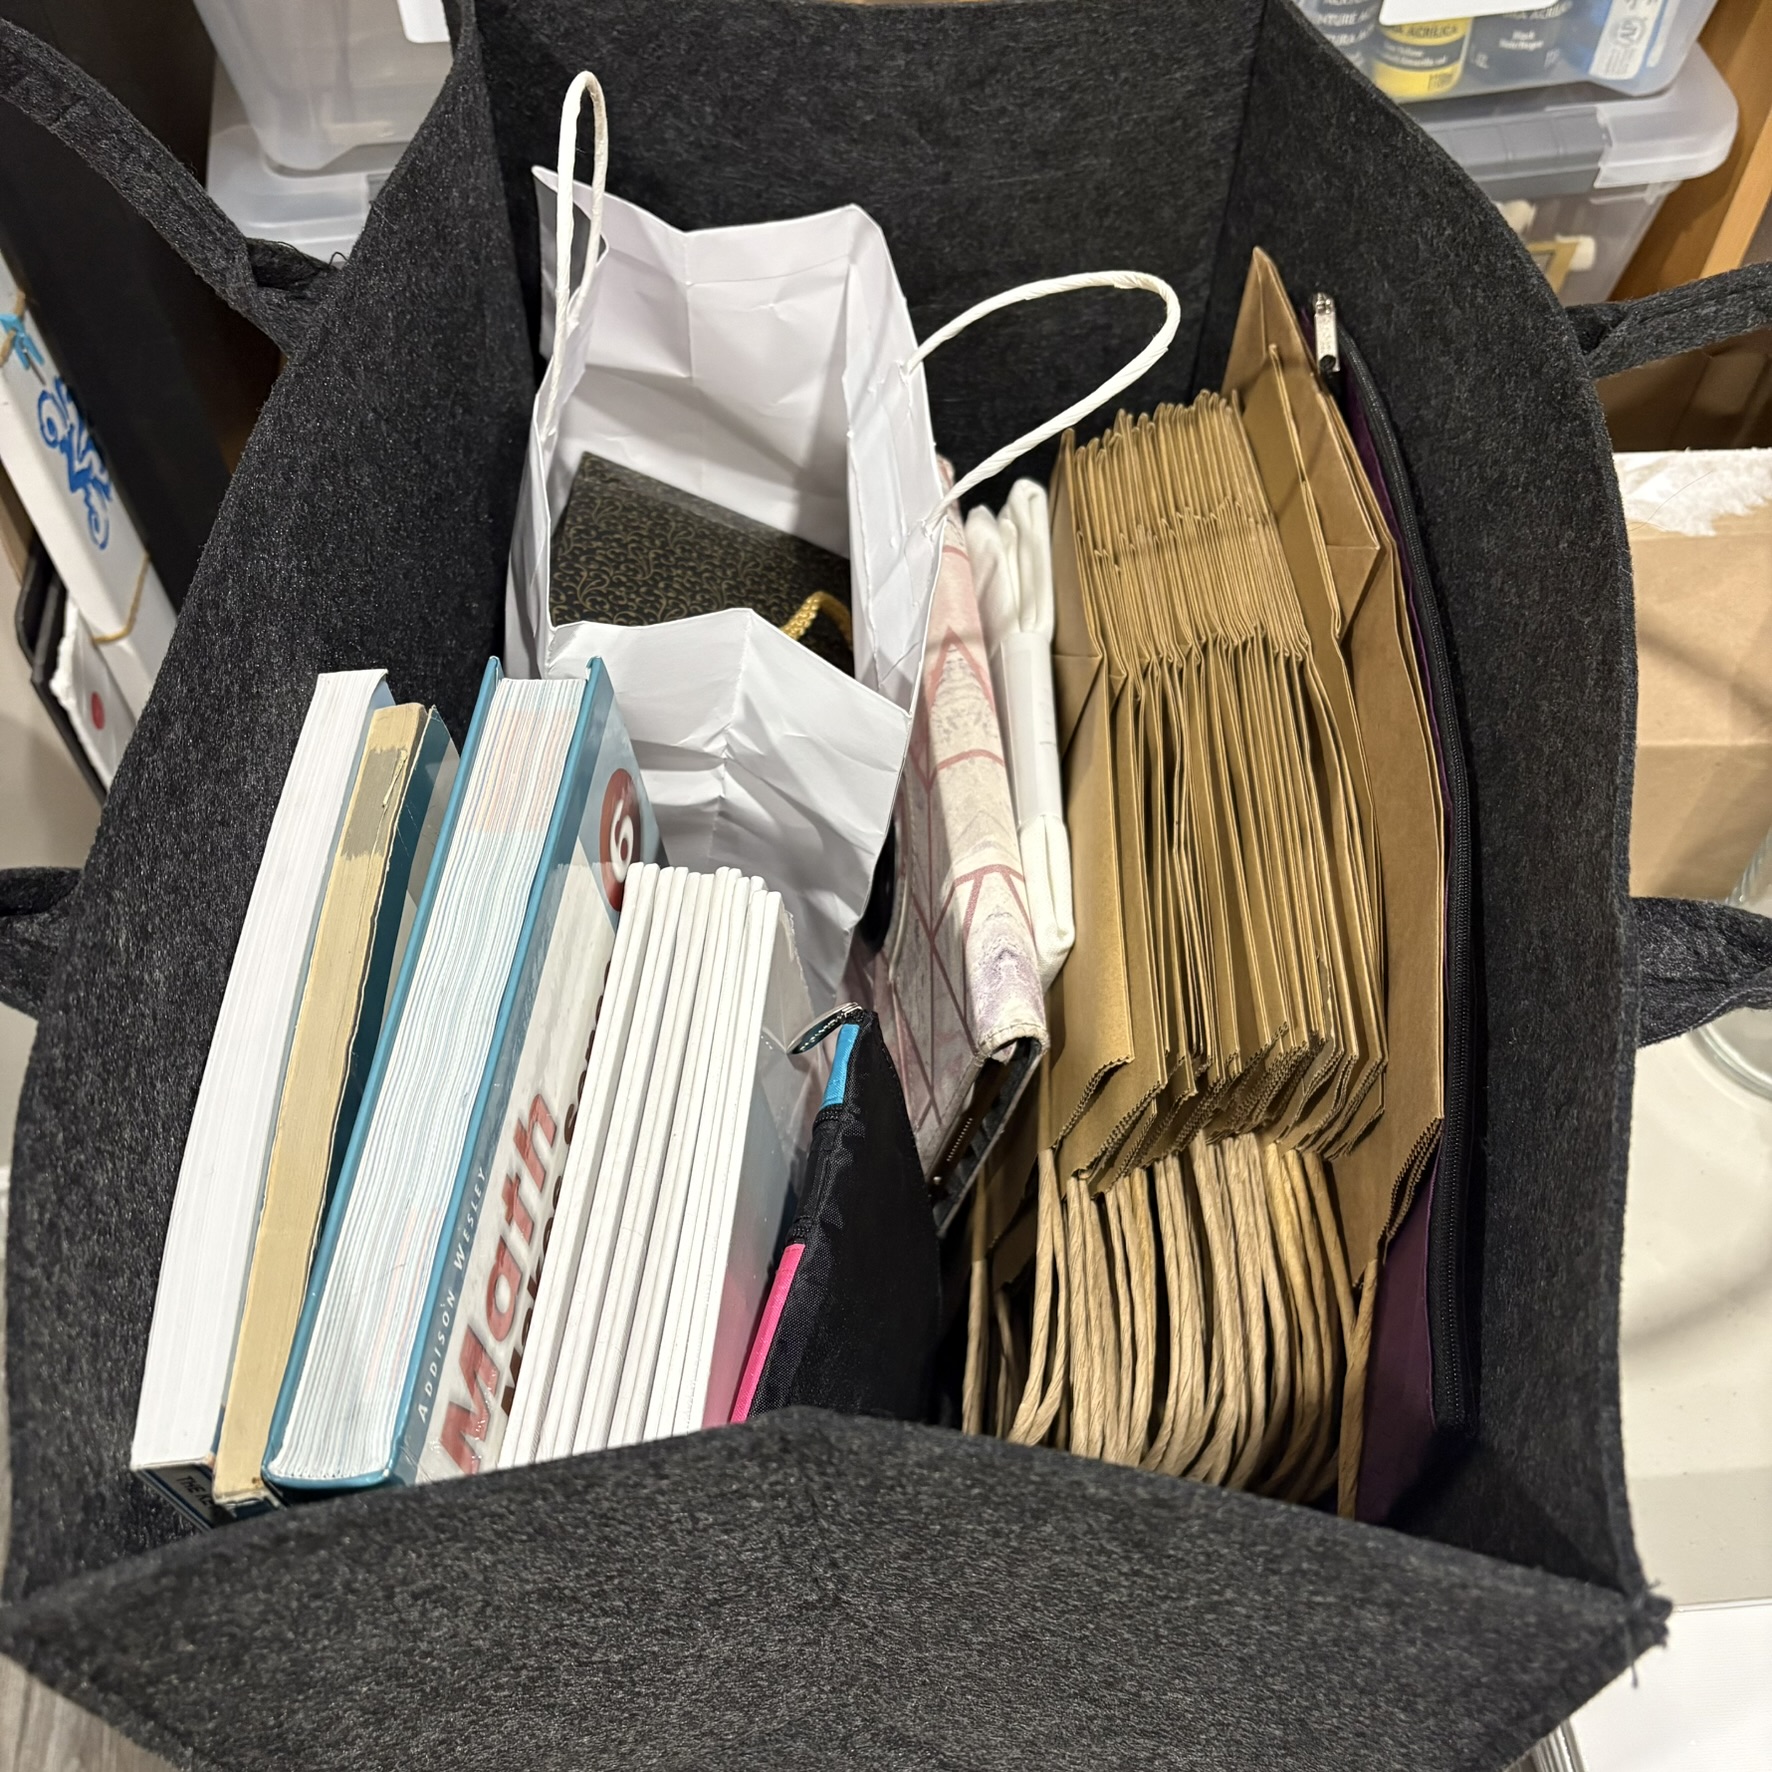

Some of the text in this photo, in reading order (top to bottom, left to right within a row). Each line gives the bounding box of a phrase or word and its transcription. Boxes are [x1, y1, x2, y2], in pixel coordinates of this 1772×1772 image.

[609, 795, 635, 884] 6
[417, 1165, 487, 1425] ADDISON WESLEY
[440, 1093, 558, 1476] Math
[176, 1475, 206, 1494] THE
